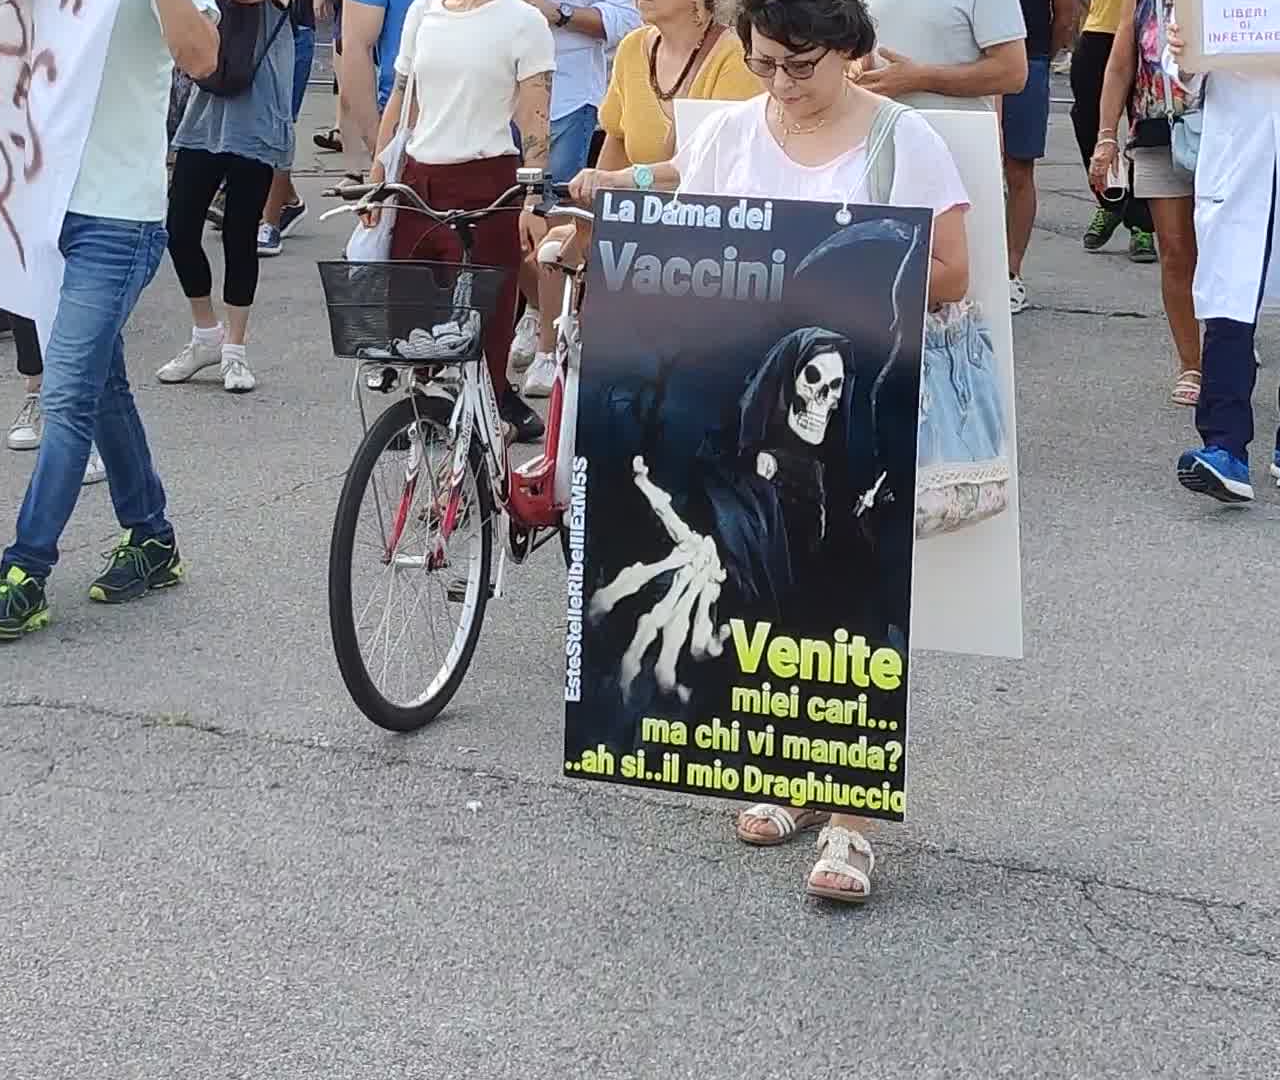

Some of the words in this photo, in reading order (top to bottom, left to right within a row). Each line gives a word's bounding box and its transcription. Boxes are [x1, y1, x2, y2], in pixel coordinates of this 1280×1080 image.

[602, 191, 636, 223] La
[641, 195, 721, 229] Dama
[727, 198, 773, 231] dei
[598, 239, 787, 304] Vaccini
[729, 618, 903, 691] Venite
[731, 681, 800, 718] miei
[806, 693, 899, 731] cari...
[641, 716, 688, 746] ma
[694, 717, 741, 753] chi
[747, 724, 775, 757] vi
[782, 735, 903, 773] manda?
[686, 758, 741, 791] mio
[742, 764, 906, 813] Draghiuccio
